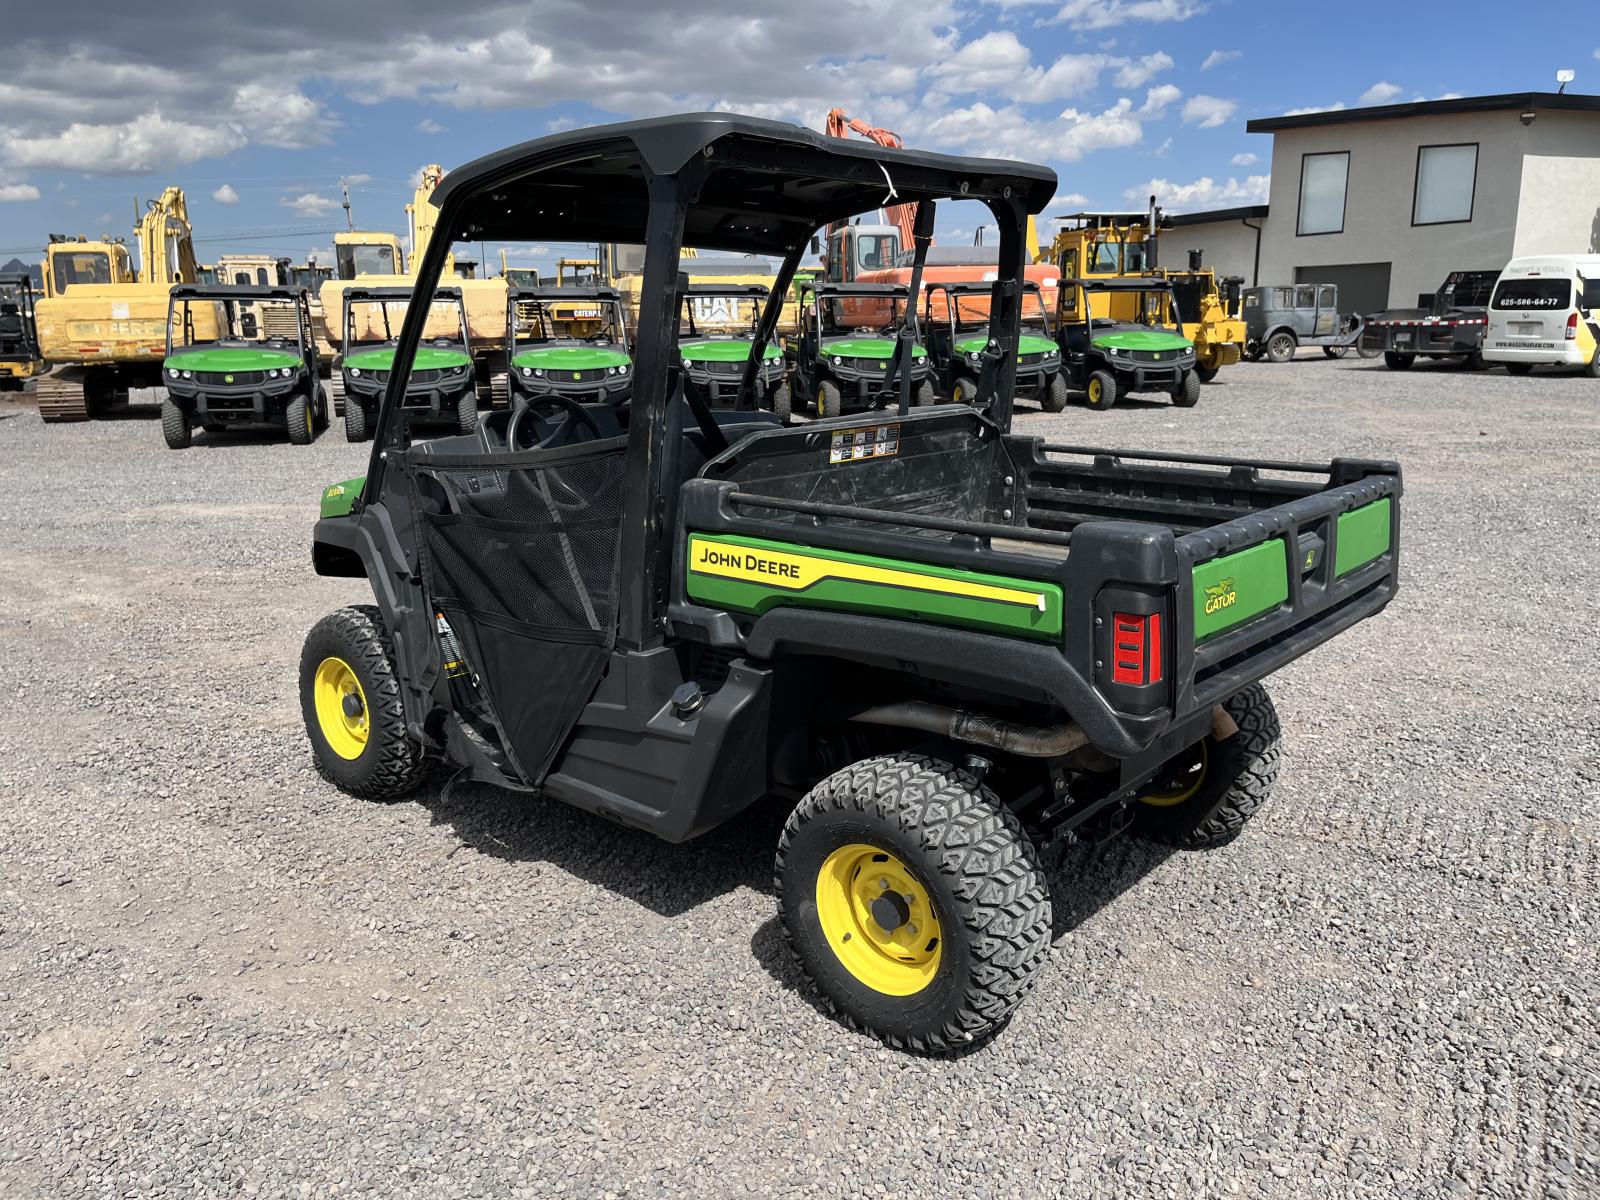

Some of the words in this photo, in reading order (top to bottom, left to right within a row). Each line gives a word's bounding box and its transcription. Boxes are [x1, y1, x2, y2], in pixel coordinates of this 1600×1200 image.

[694, 297, 738, 321] CAT
[700, 548, 741, 568] JOHN
[745, 554, 800, 579] DEERE
[1205, 591, 1236, 614] GATOR
